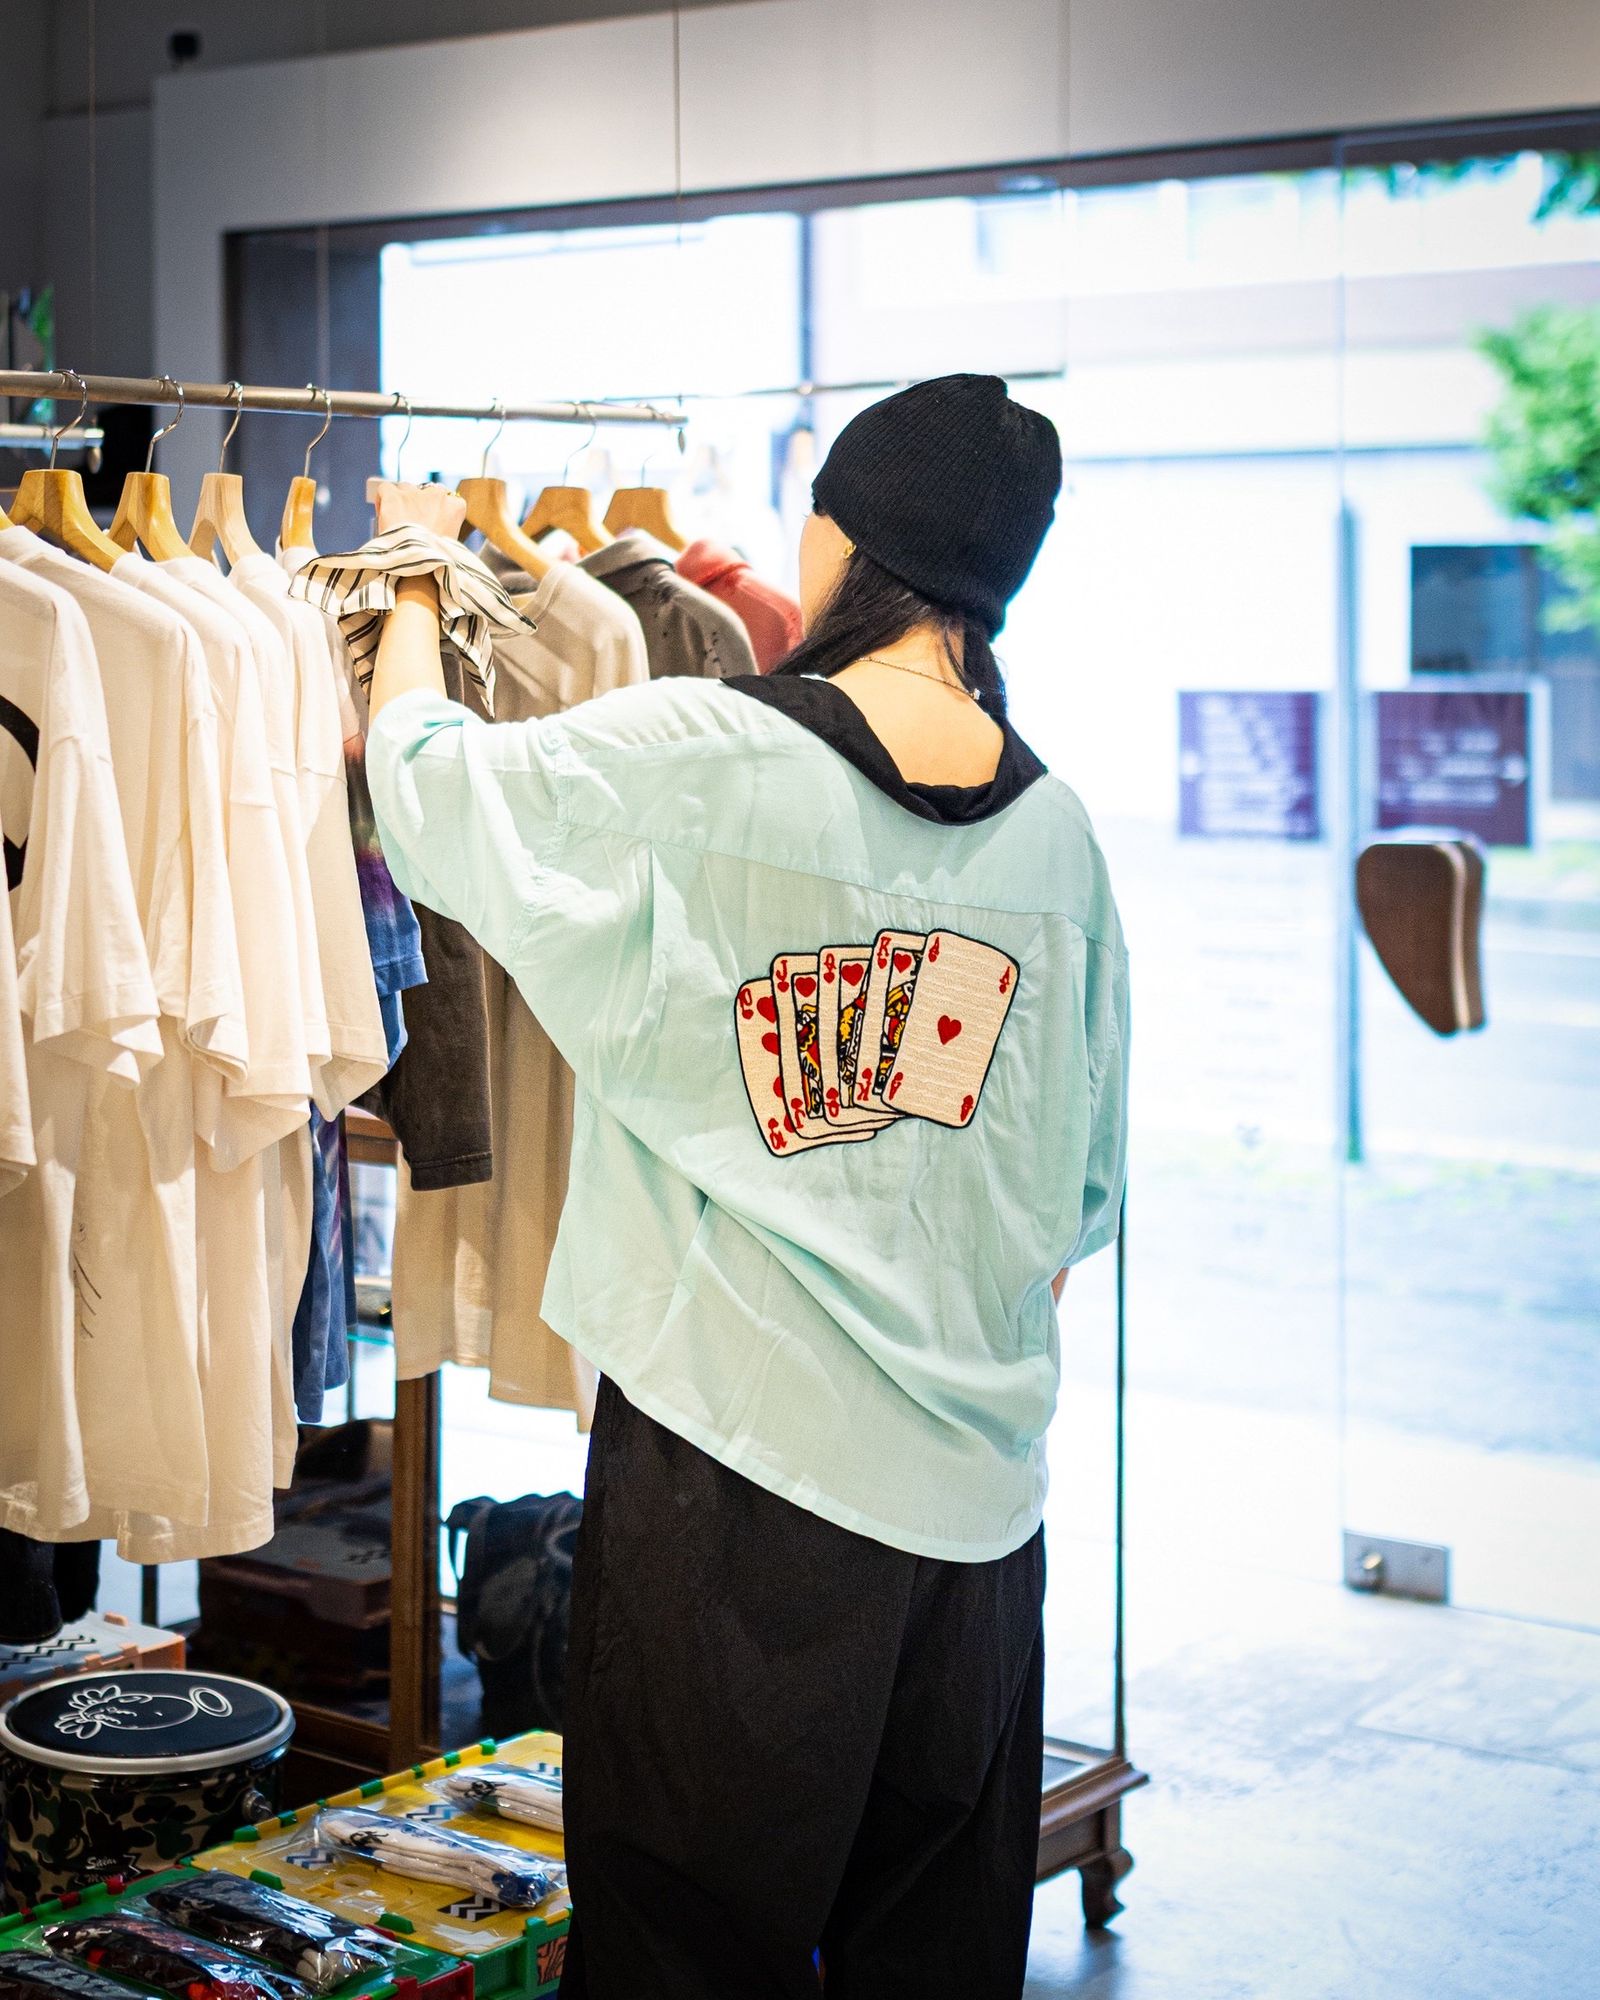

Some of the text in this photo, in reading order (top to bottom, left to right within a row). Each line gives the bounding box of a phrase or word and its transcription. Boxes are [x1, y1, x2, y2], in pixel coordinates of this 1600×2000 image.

[877, 937, 891, 957] K
[929, 937, 940, 954] A
[775, 960, 788, 981] J
[824, 953, 836, 970] Q
[999, 966, 1010, 985] A
[856, 1081, 871, 1100] K
